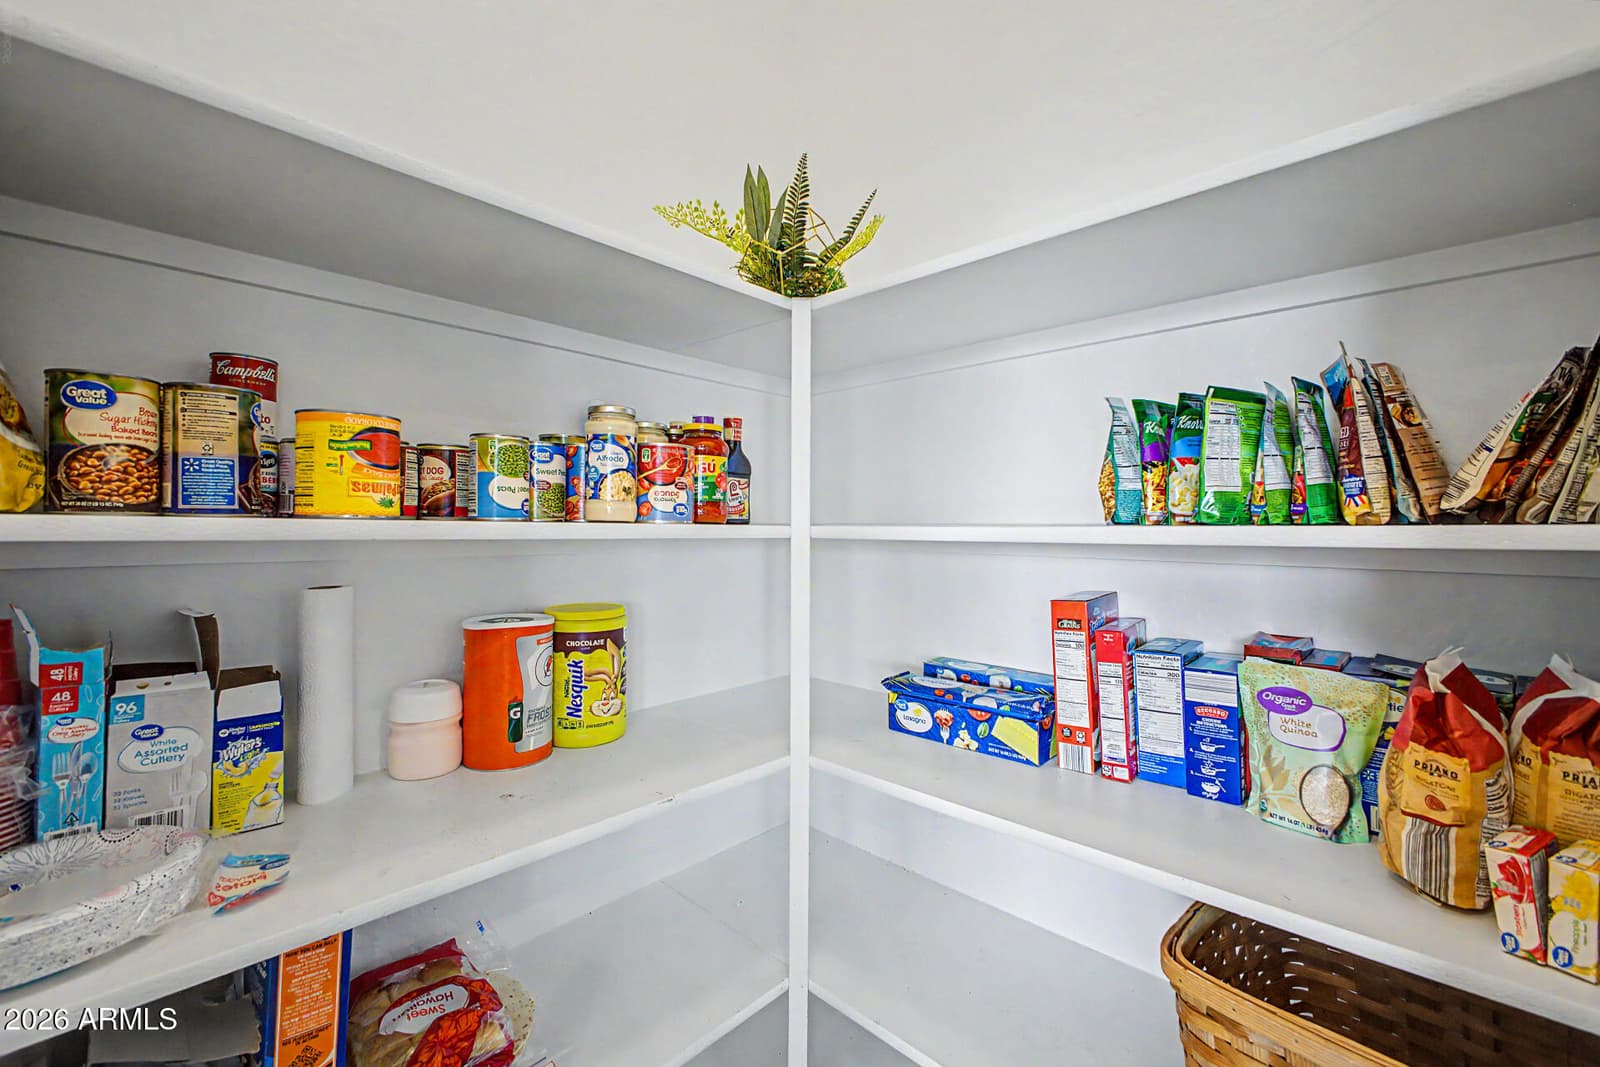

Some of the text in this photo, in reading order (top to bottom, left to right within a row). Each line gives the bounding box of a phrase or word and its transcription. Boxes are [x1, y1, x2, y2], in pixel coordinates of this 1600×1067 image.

[216, 360, 276, 382] Campbell's
[66, 385, 108, 399] Great
[75, 396, 107, 405] Value
[99, 411, 131, 427] Sugar
[111, 424, 140, 435] Baked
[596, 454, 625, 463] Alfredo
[426, 466, 444, 475] DOG
[535, 467, 559, 475] Sweet
[496, 485, 517, 494] Peas
[565, 639, 605, 647] CHOCOLATE
[50, 668, 65, 681] 48
[566, 659, 589, 719] Nesquik
[51, 690, 72, 702] 48
[1262, 691, 1307, 705] Organic
[115, 702, 138, 716] 96
[510, 707, 521, 719] G
[1280, 717, 1312, 729] White
[134, 727, 160, 736] Great
[1279, 724, 1319, 738] Quinoa
[150, 738, 177, 748] White
[134, 742, 189, 759] Assorted
[140, 753, 185, 767] Cutlery
[1414, 759, 1459, 779] PRIANO
[405, 1003, 447, 1022] Sweet
